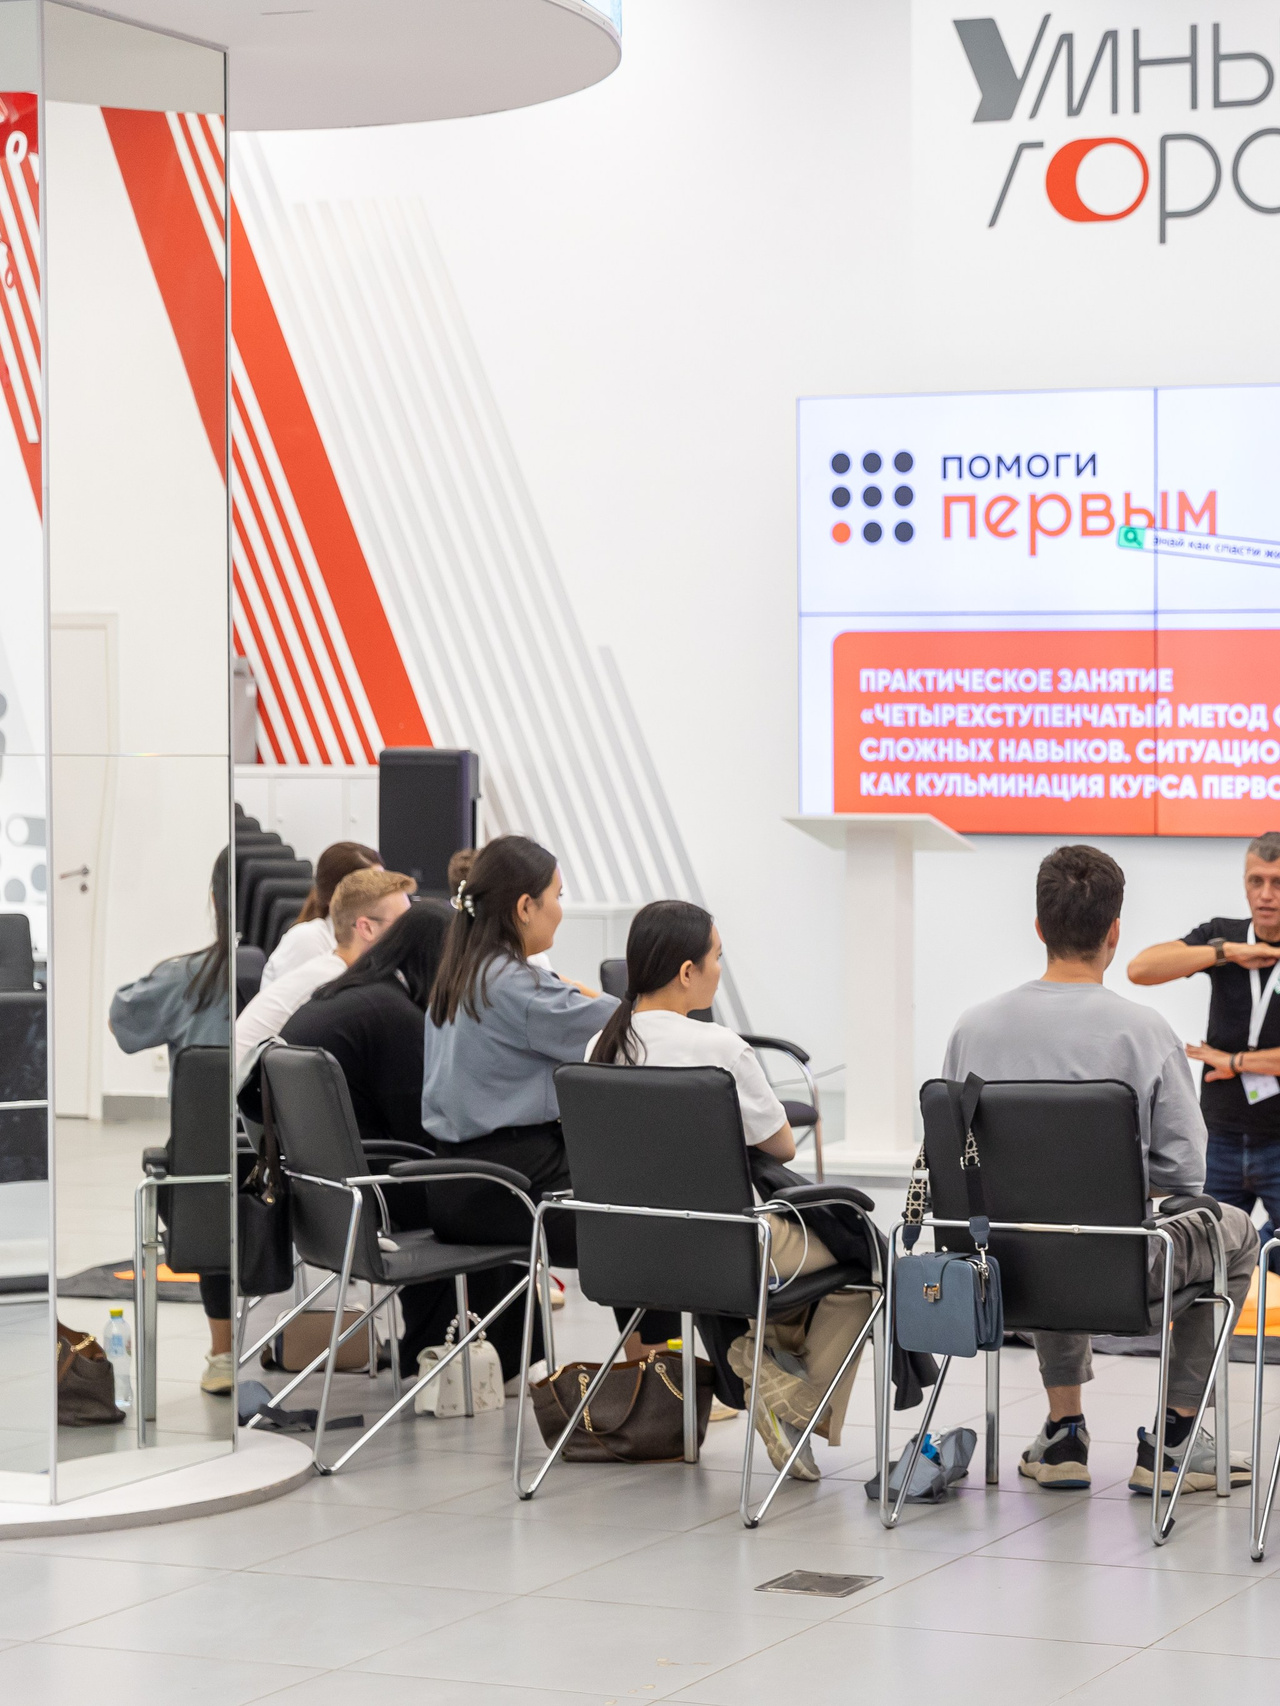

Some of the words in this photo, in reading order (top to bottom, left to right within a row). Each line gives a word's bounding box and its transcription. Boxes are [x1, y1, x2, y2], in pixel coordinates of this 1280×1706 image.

[859, 668, 1053, 692] ПРАКТИЧЕСКОЕ
[1057, 668, 1174, 692] ЗАНЯТИЕ
[860, 698, 1173, 728] «ЧЕТЫРЕХСТУПЕНЧАТЫЙ
[1177, 703, 1269, 732] МЕТОД
[859, 737, 994, 763] СЛОЖНЫХ
[998, 738, 1132, 764] НАВЫКОВ.
[860, 772, 912, 797] КАК
[915, 773, 1105, 802] КУЛЬМИНАЦИЯ
[1109, 774, 1199, 800] КУРСА
